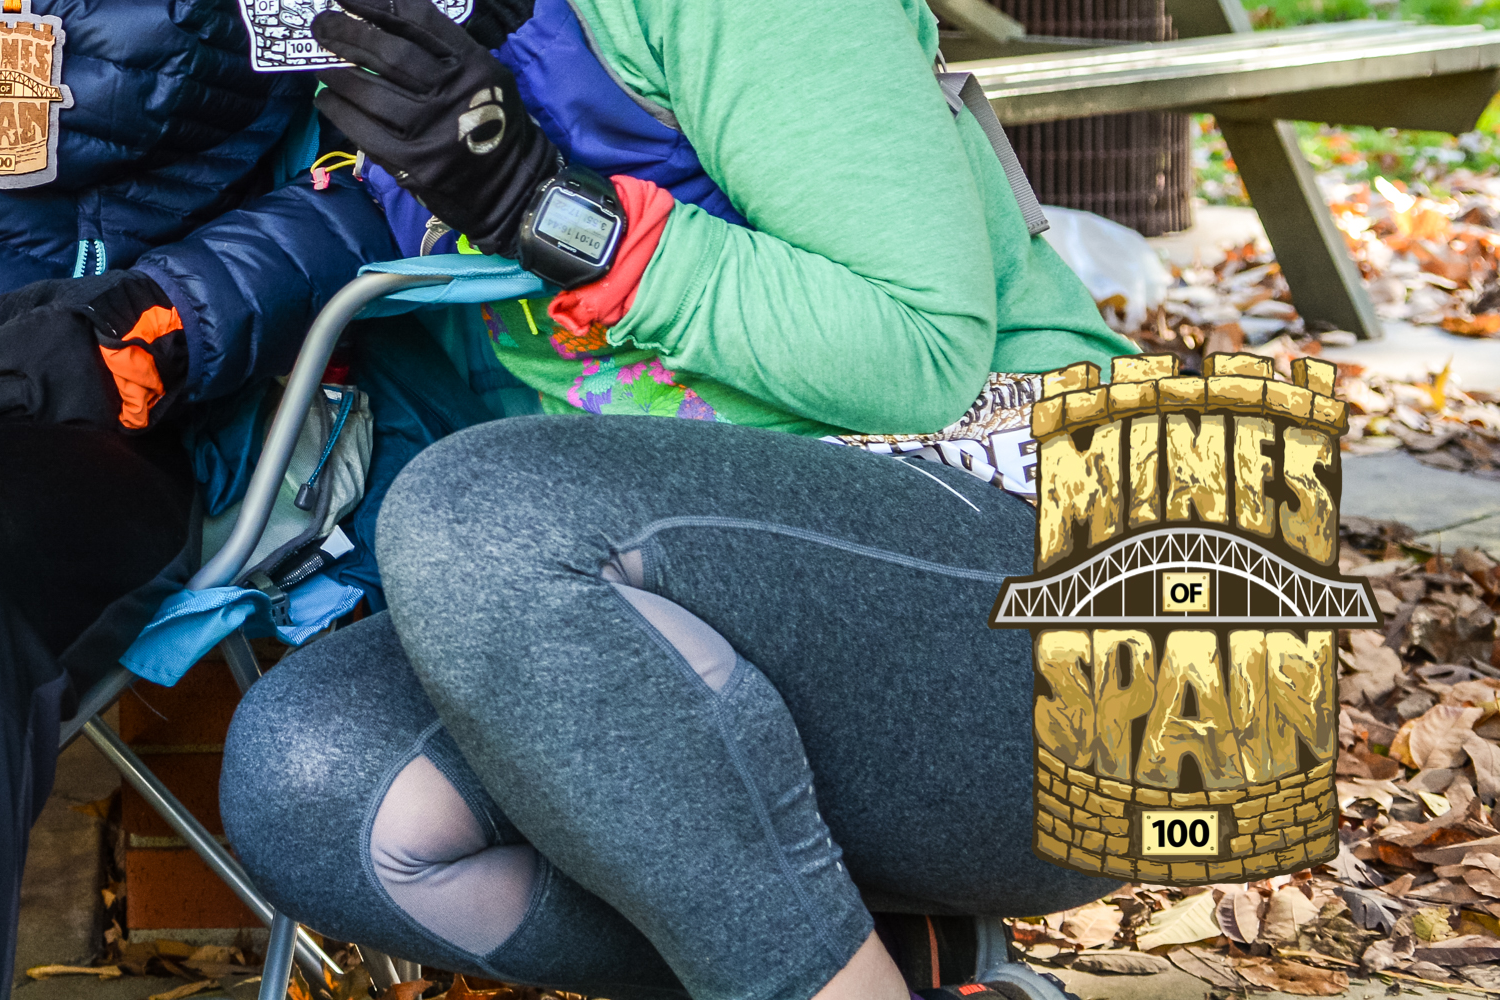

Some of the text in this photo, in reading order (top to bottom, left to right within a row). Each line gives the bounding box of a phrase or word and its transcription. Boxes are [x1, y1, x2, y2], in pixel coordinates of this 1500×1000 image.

[258, 0, 276, 11] OF
[290, 43, 312, 53] 100
[0, 84, 11, 93] OF
